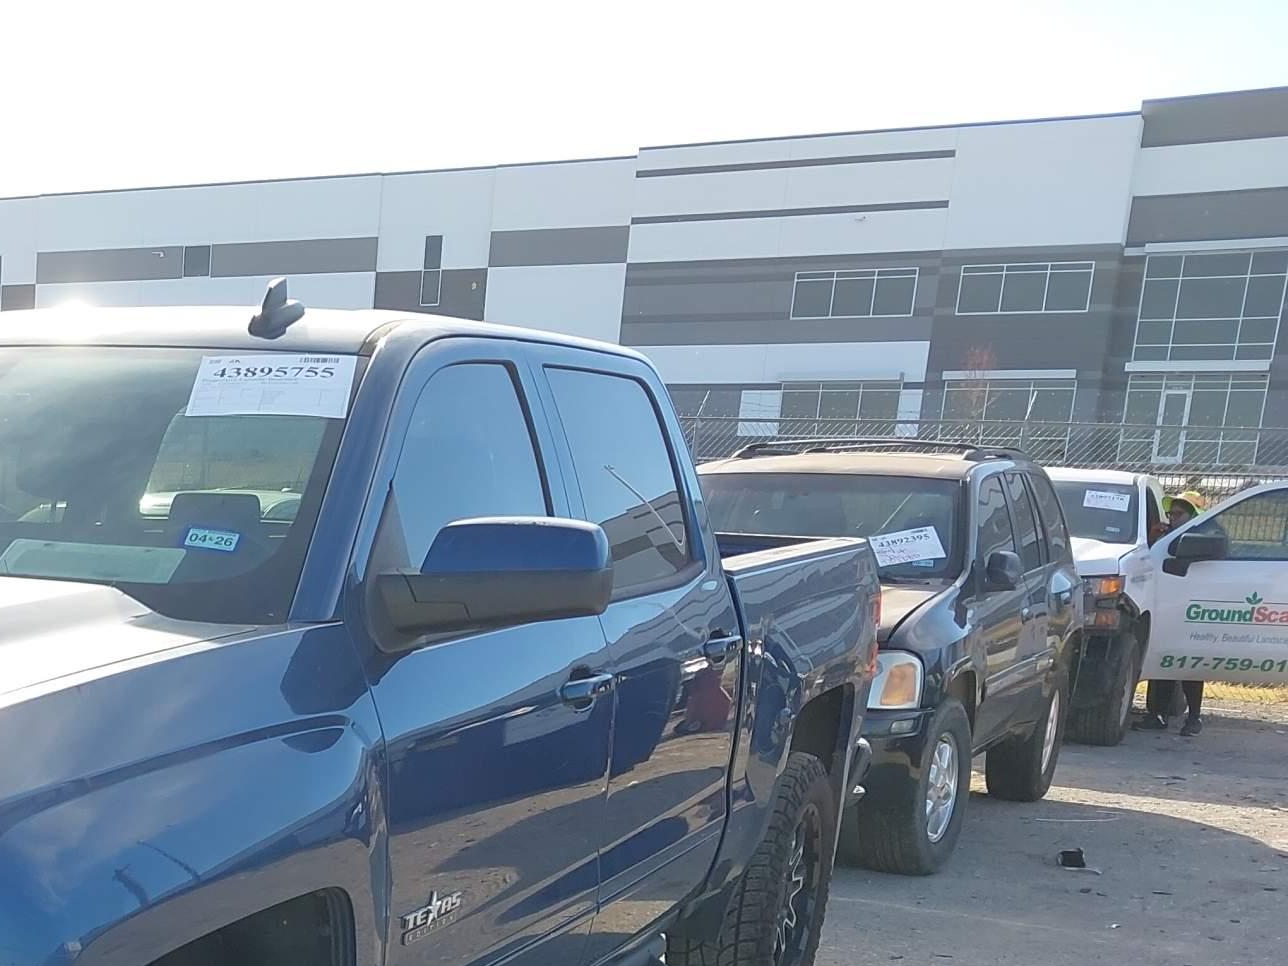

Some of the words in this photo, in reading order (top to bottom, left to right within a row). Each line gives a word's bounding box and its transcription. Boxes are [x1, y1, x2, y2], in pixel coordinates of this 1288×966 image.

[213, 366, 335, 378] 43895755
[878, 533, 931, 548] 43892395
[1185, 603, 1288, 623] GroundSca
[402, 890, 463, 930] TEXAS
[407, 915, 454, 942] EDITION
